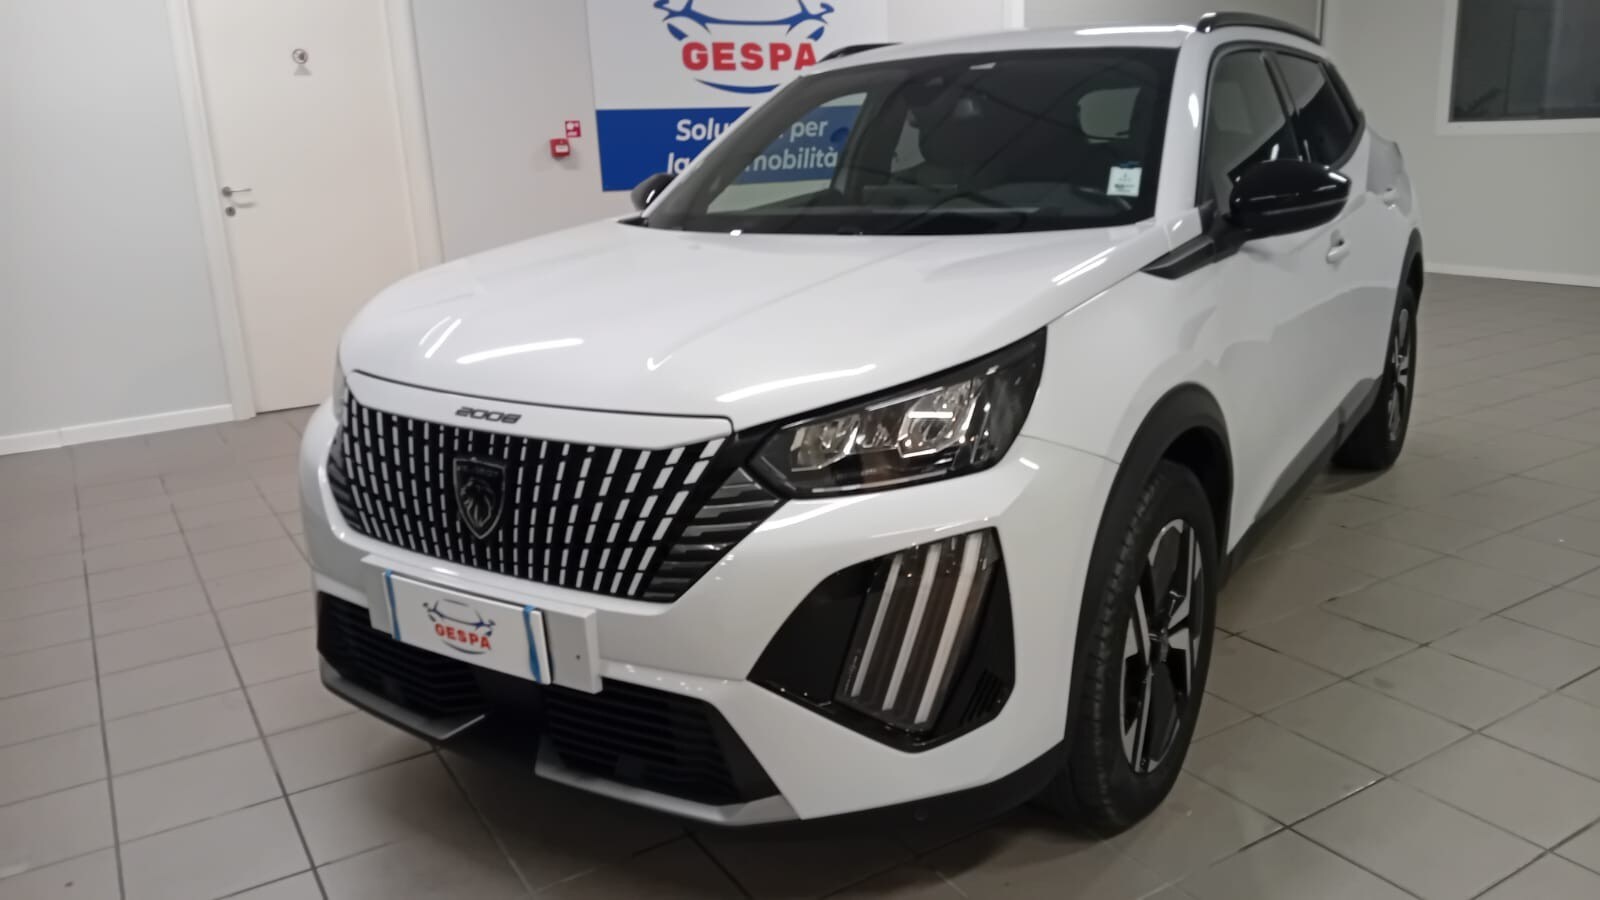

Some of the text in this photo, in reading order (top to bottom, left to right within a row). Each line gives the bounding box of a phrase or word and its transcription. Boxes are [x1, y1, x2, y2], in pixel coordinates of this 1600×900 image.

[682, 42, 817, 71] GESPA
[790, 121, 828, 143] per
[667, 152, 690, 175] la
[455, 406, 522, 424] 2008
[435, 623, 491, 650] GESPA
